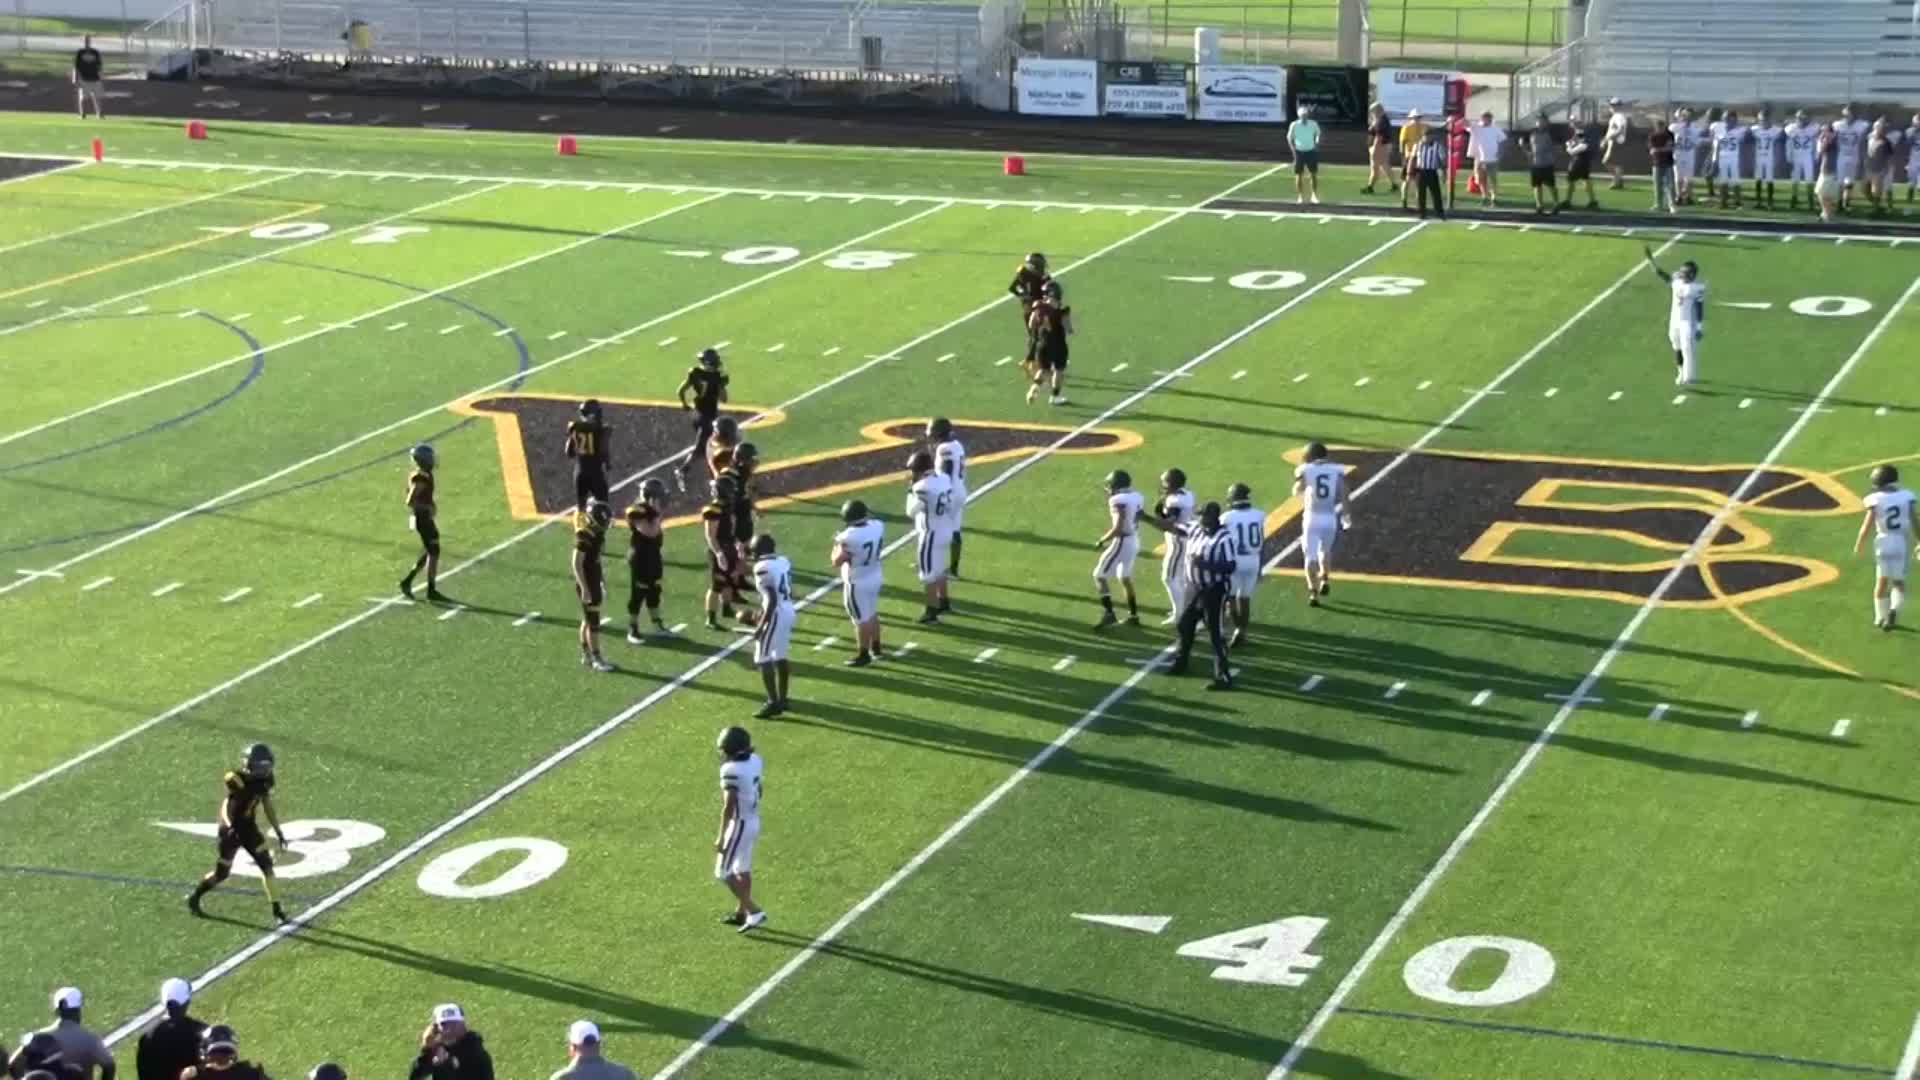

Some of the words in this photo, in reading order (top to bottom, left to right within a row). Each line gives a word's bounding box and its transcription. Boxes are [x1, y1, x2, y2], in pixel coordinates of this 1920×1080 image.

[576, 431, 595, 456] 21
[1315, 474, 1330, 499] 6
[1886, 505, 1901, 530] 2
[1236, 521, 1262, 556] 10
